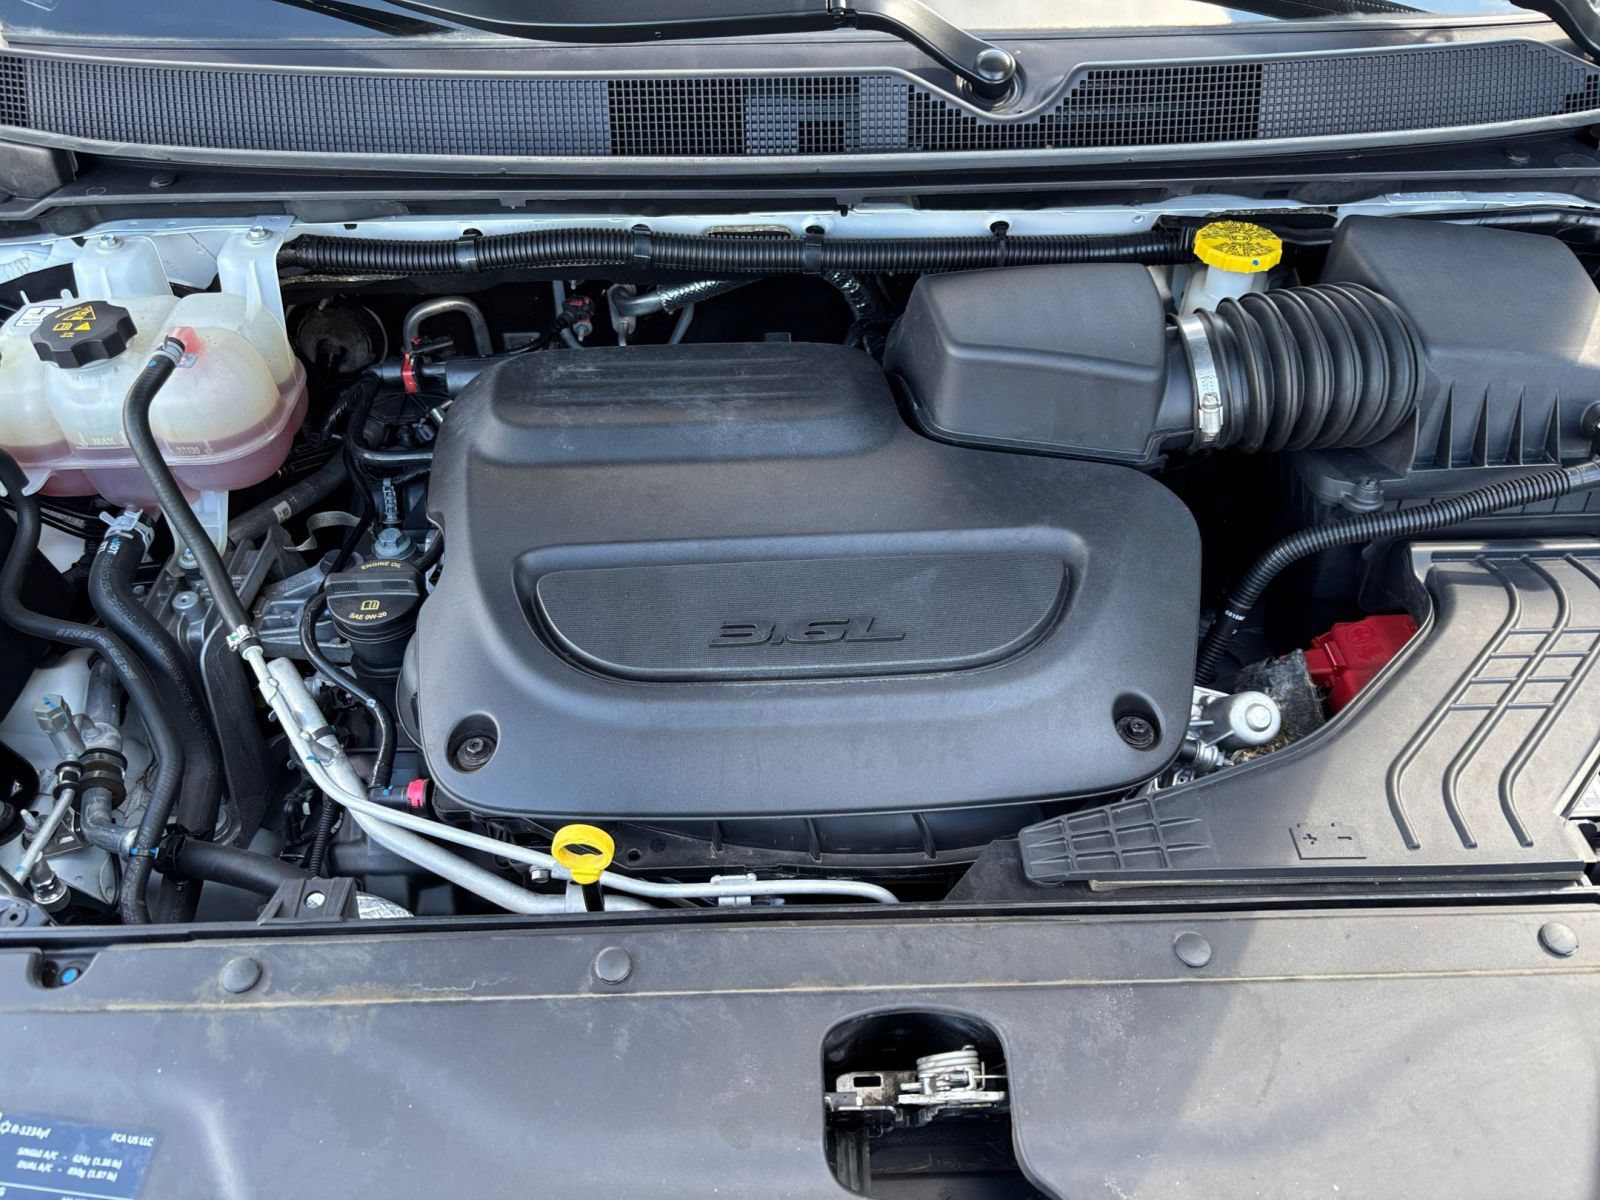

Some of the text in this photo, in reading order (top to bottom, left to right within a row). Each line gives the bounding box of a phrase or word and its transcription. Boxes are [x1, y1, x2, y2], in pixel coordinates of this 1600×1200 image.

[361, 561, 402, 570] ENGINE OIL
[349, 611, 388, 620] SAE 0W-20
[708, 616, 907, 648] 3.6L
[111, 1133, 154, 1147] FCA US LLC
